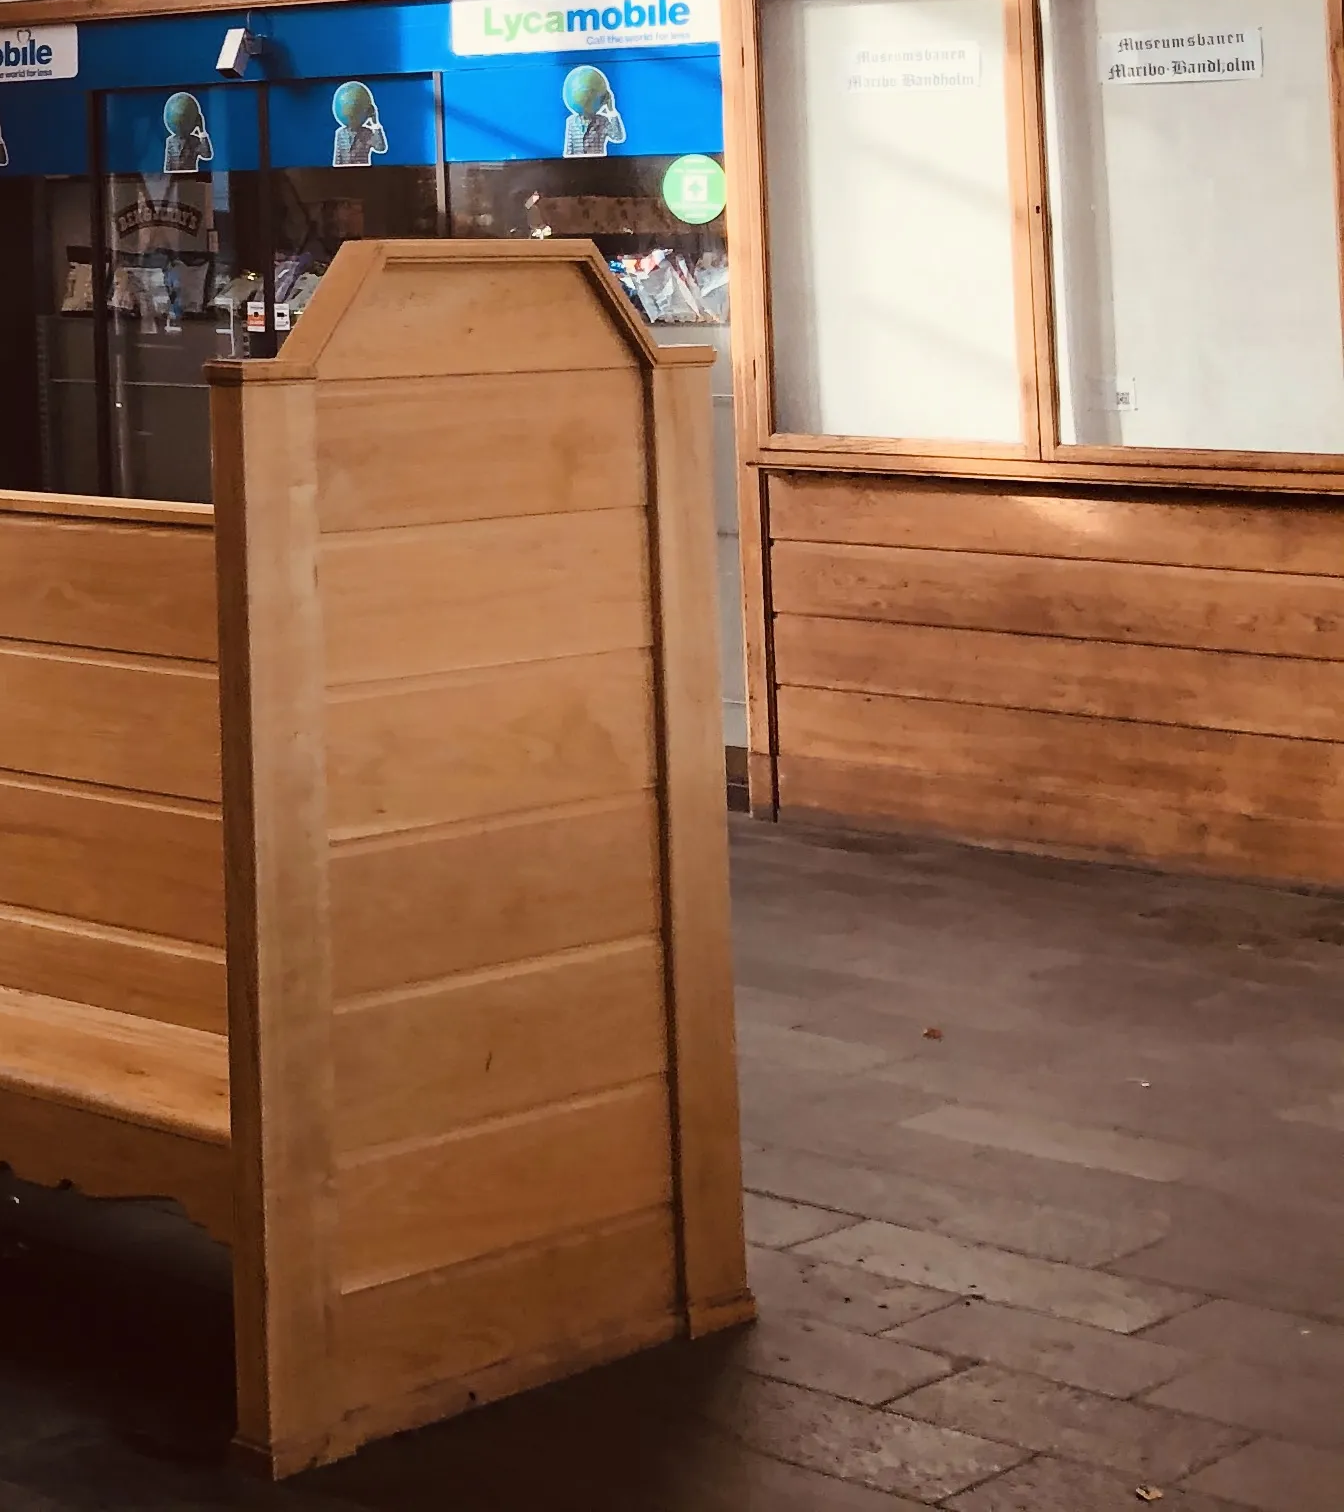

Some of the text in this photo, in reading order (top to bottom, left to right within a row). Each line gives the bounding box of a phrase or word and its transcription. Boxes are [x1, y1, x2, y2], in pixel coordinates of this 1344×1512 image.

[586, 35, 606, 45] Call
[607, 35, 622, 43] the
[1117, 33, 1245, 53] Museumsbanen
